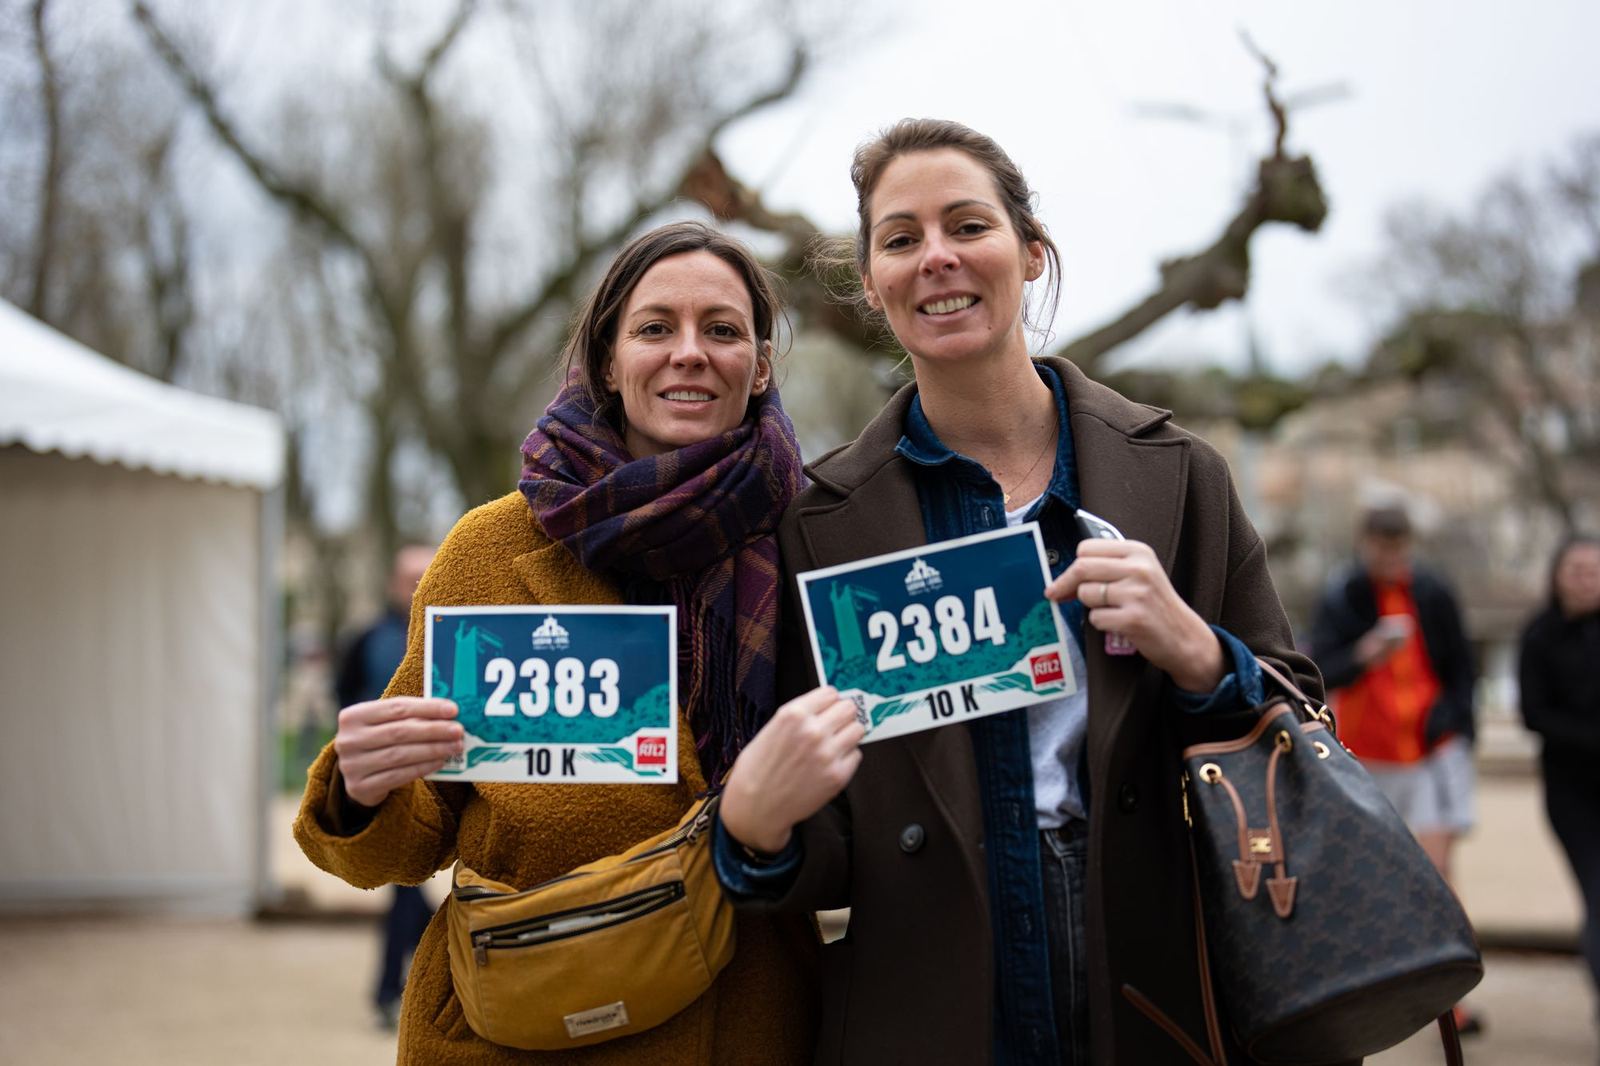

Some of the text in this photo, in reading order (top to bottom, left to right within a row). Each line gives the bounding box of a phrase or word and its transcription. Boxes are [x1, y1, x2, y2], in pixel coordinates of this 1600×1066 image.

[867, 586, 1006, 673] 2384
[1034, 659, 1061, 676] RTL2
[484, 657, 620, 718] 2383
[925, 683, 979, 720] 10 K
[523, 748, 576, 776] 10 K
[638, 742, 666, 757] RTL2
